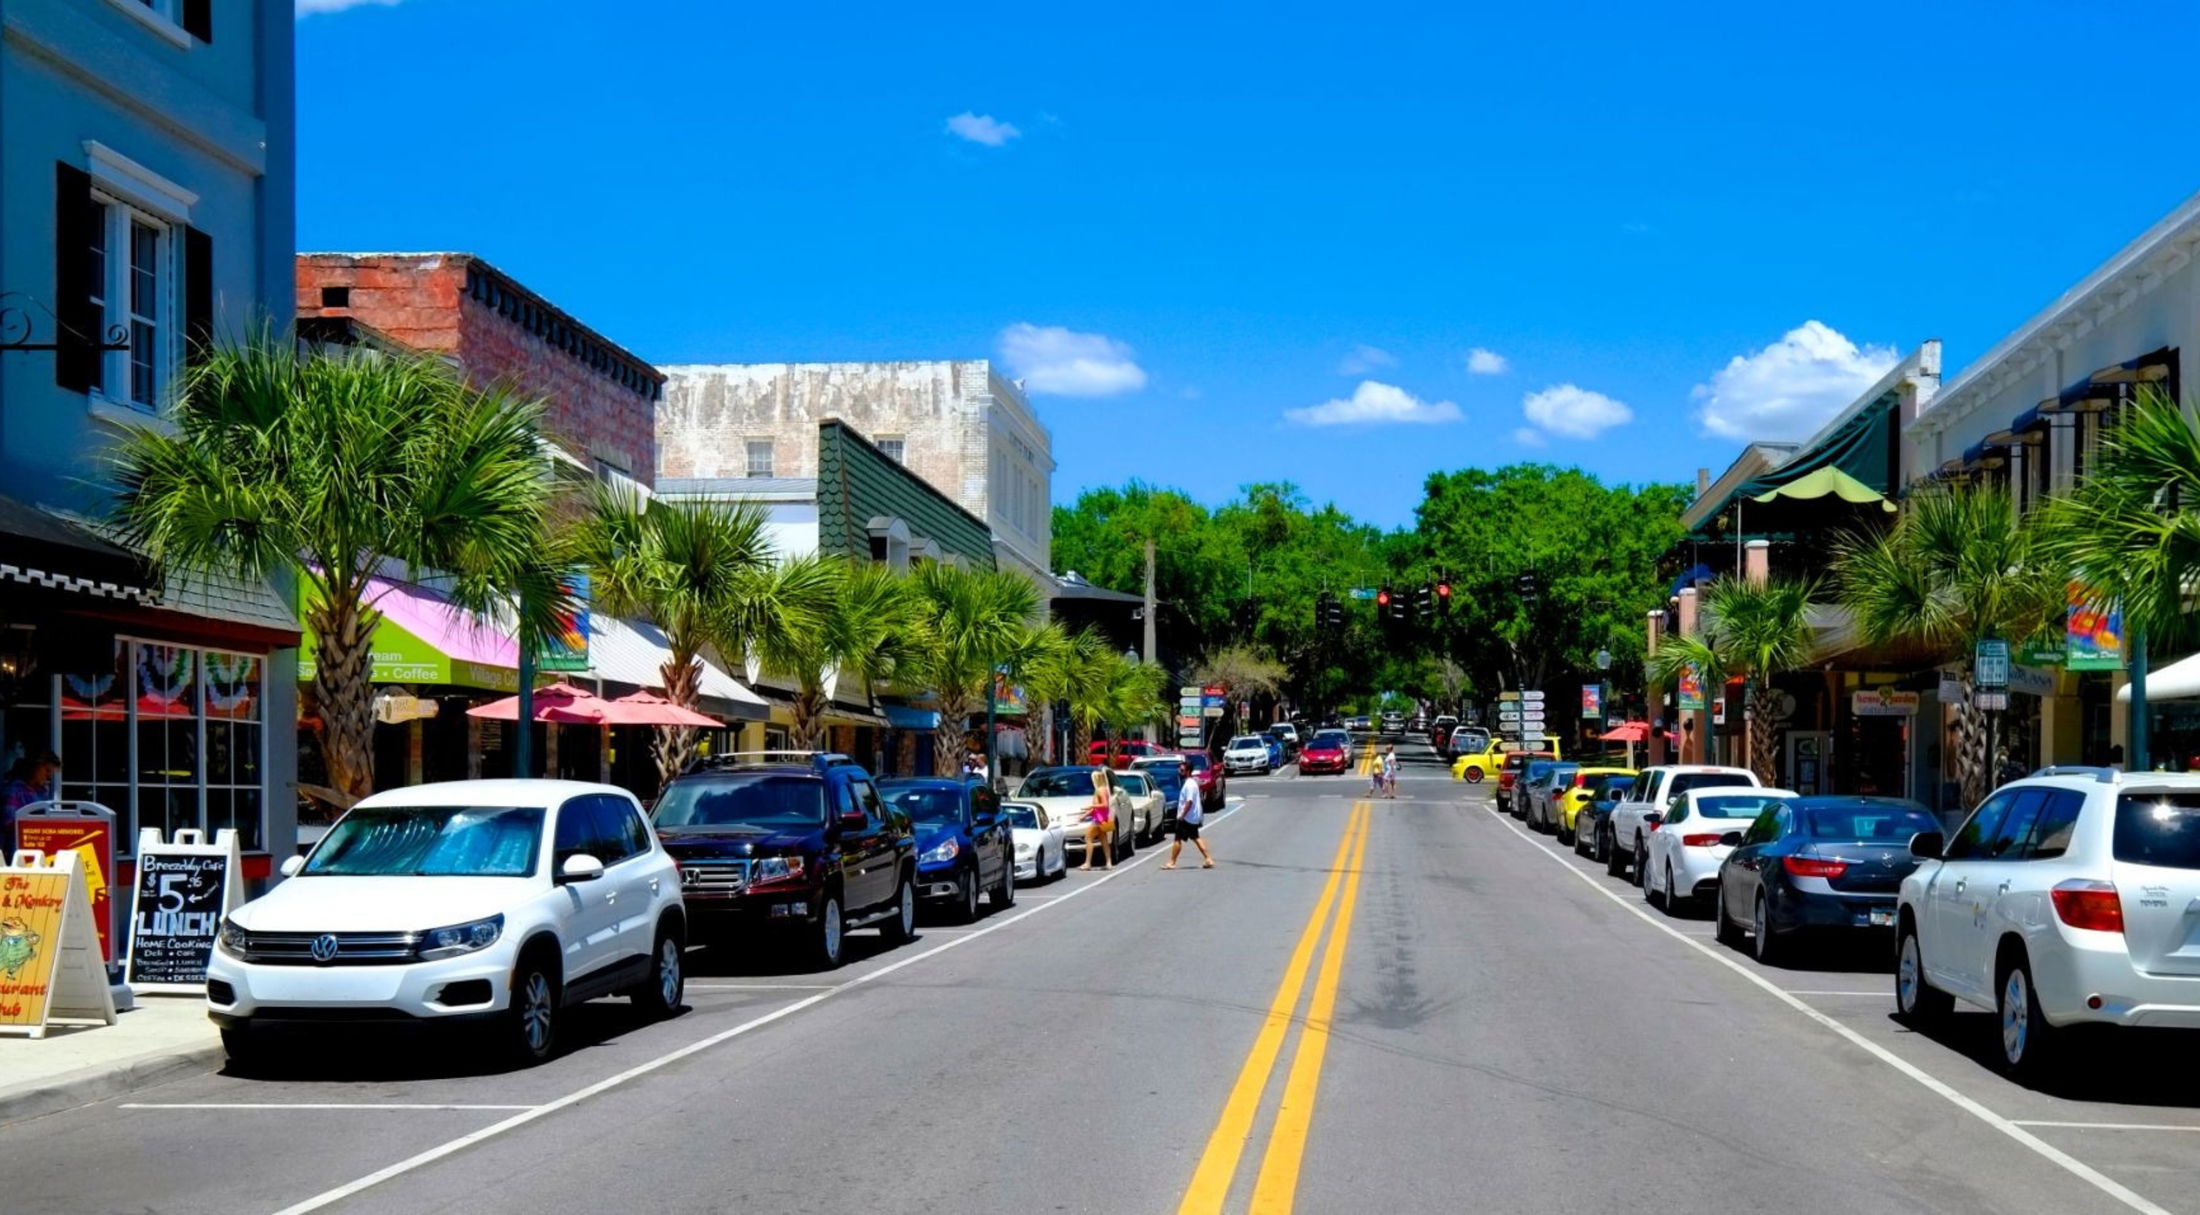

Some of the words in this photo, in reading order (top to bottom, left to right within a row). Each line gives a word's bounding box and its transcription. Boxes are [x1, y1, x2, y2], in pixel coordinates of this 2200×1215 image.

[393, 668, 438, 680] Coffee
[471, 666, 501, 689] Village
[4, 877, 30, 890] The
[14, 893, 63, 913] Monkey
[136, 911, 216, 936] LUNCH
[0, 985, 47, 995] urant
